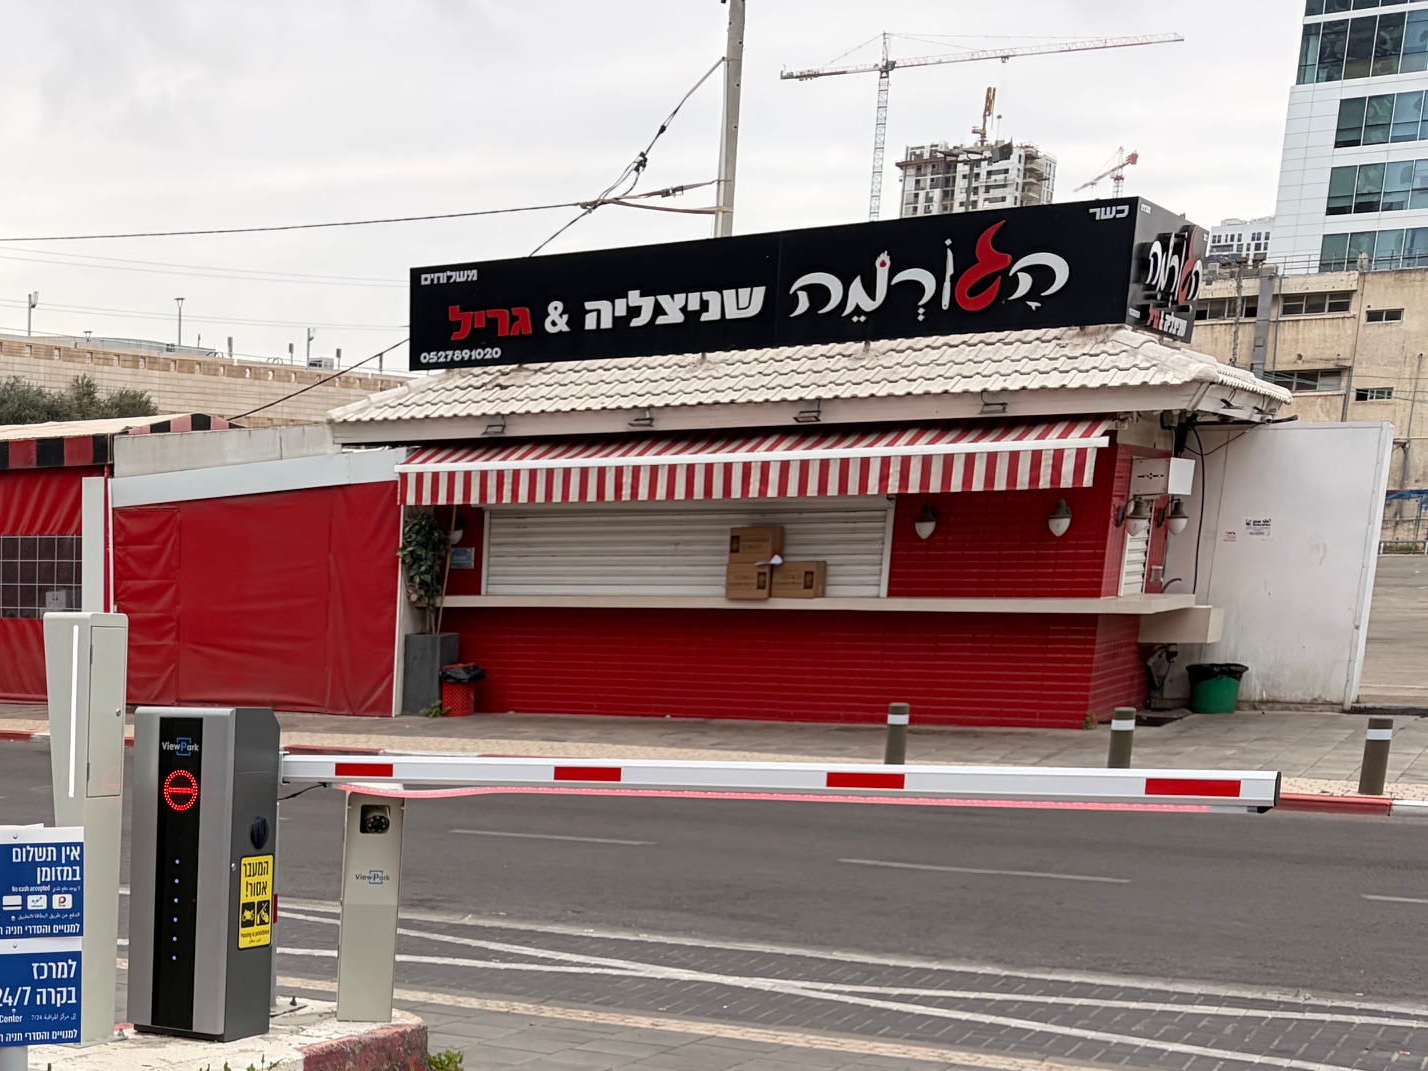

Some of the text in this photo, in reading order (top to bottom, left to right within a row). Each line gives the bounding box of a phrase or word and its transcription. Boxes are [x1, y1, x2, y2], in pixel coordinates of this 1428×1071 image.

[1088, 204, 1129, 221] כשר
[420, 268, 478, 286] משלוחים
[584, 285, 766, 331] שניצליה
[448, 305, 533, 341] גריל
[544, 300, 570, 334] &
[420, 347, 502, 364] 0527891020
[161, 741, 200, 752] ViewPark
[12, 845, 80, 863] אין תשלום
[37, 866, 81, 884] במזומן
[242, 861, 269, 878] המעבר
[245, 880, 268, 898] אסור!
[5, 925, 23, 935] חניה
[25, 924, 50, 935] והסדרי
[52, 923, 80, 934] למנויים
[31, 958, 77, 980] למרכז
[36, 986, 77, 1007] בקרה
[5, 1032, 23, 1042] חניה
[24, 1031, 50, 1041] והסדרי
[52, 1029, 78, 1040] למנויים
